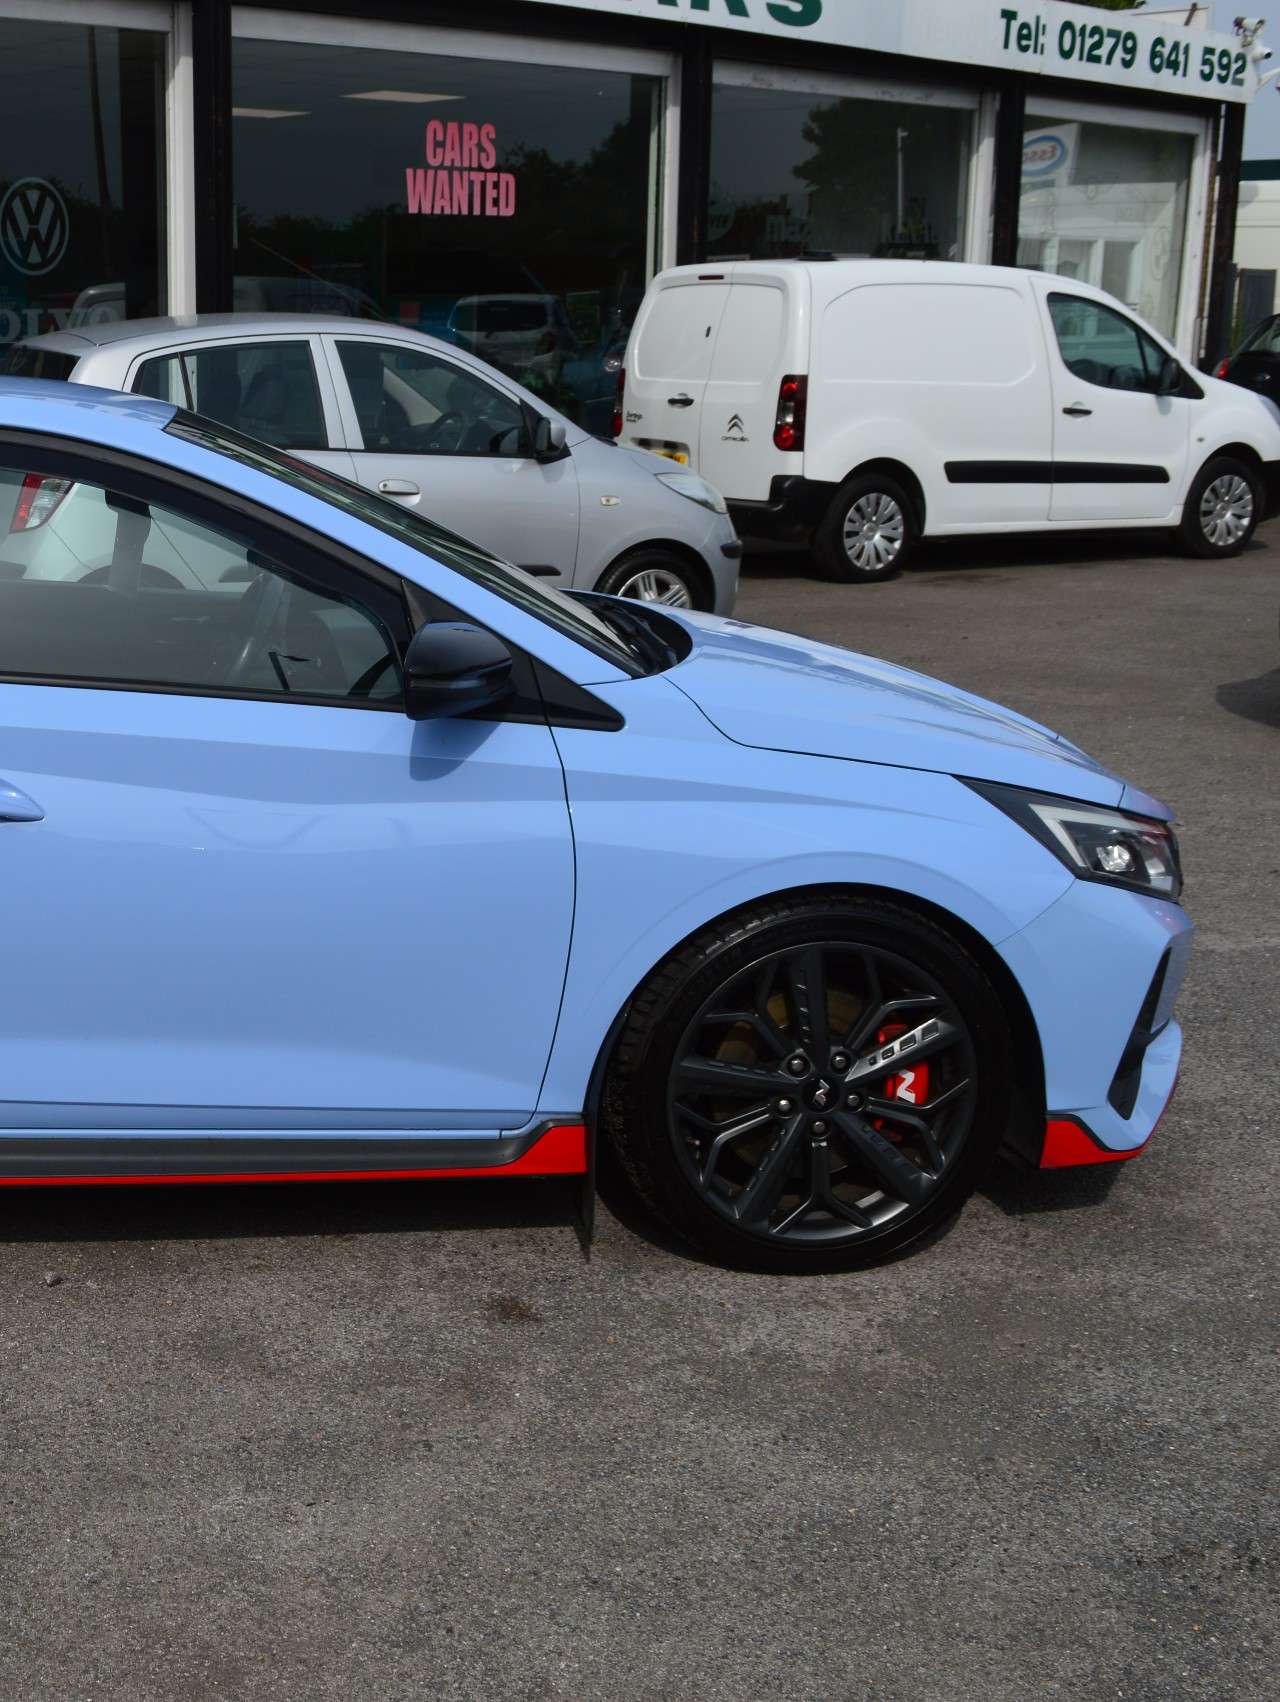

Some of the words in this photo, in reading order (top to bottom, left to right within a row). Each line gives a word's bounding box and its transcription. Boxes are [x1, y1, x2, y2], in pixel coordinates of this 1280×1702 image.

[1000, 8, 1046, 55] Tel:
[1058, 20, 1137, 69] 01279
[1149, 36, 1190, 78] 641
[1200, 47, 1247, 86] 592
[426, 119, 496, 169] CARS
[406, 167, 516, 216] WANTED
